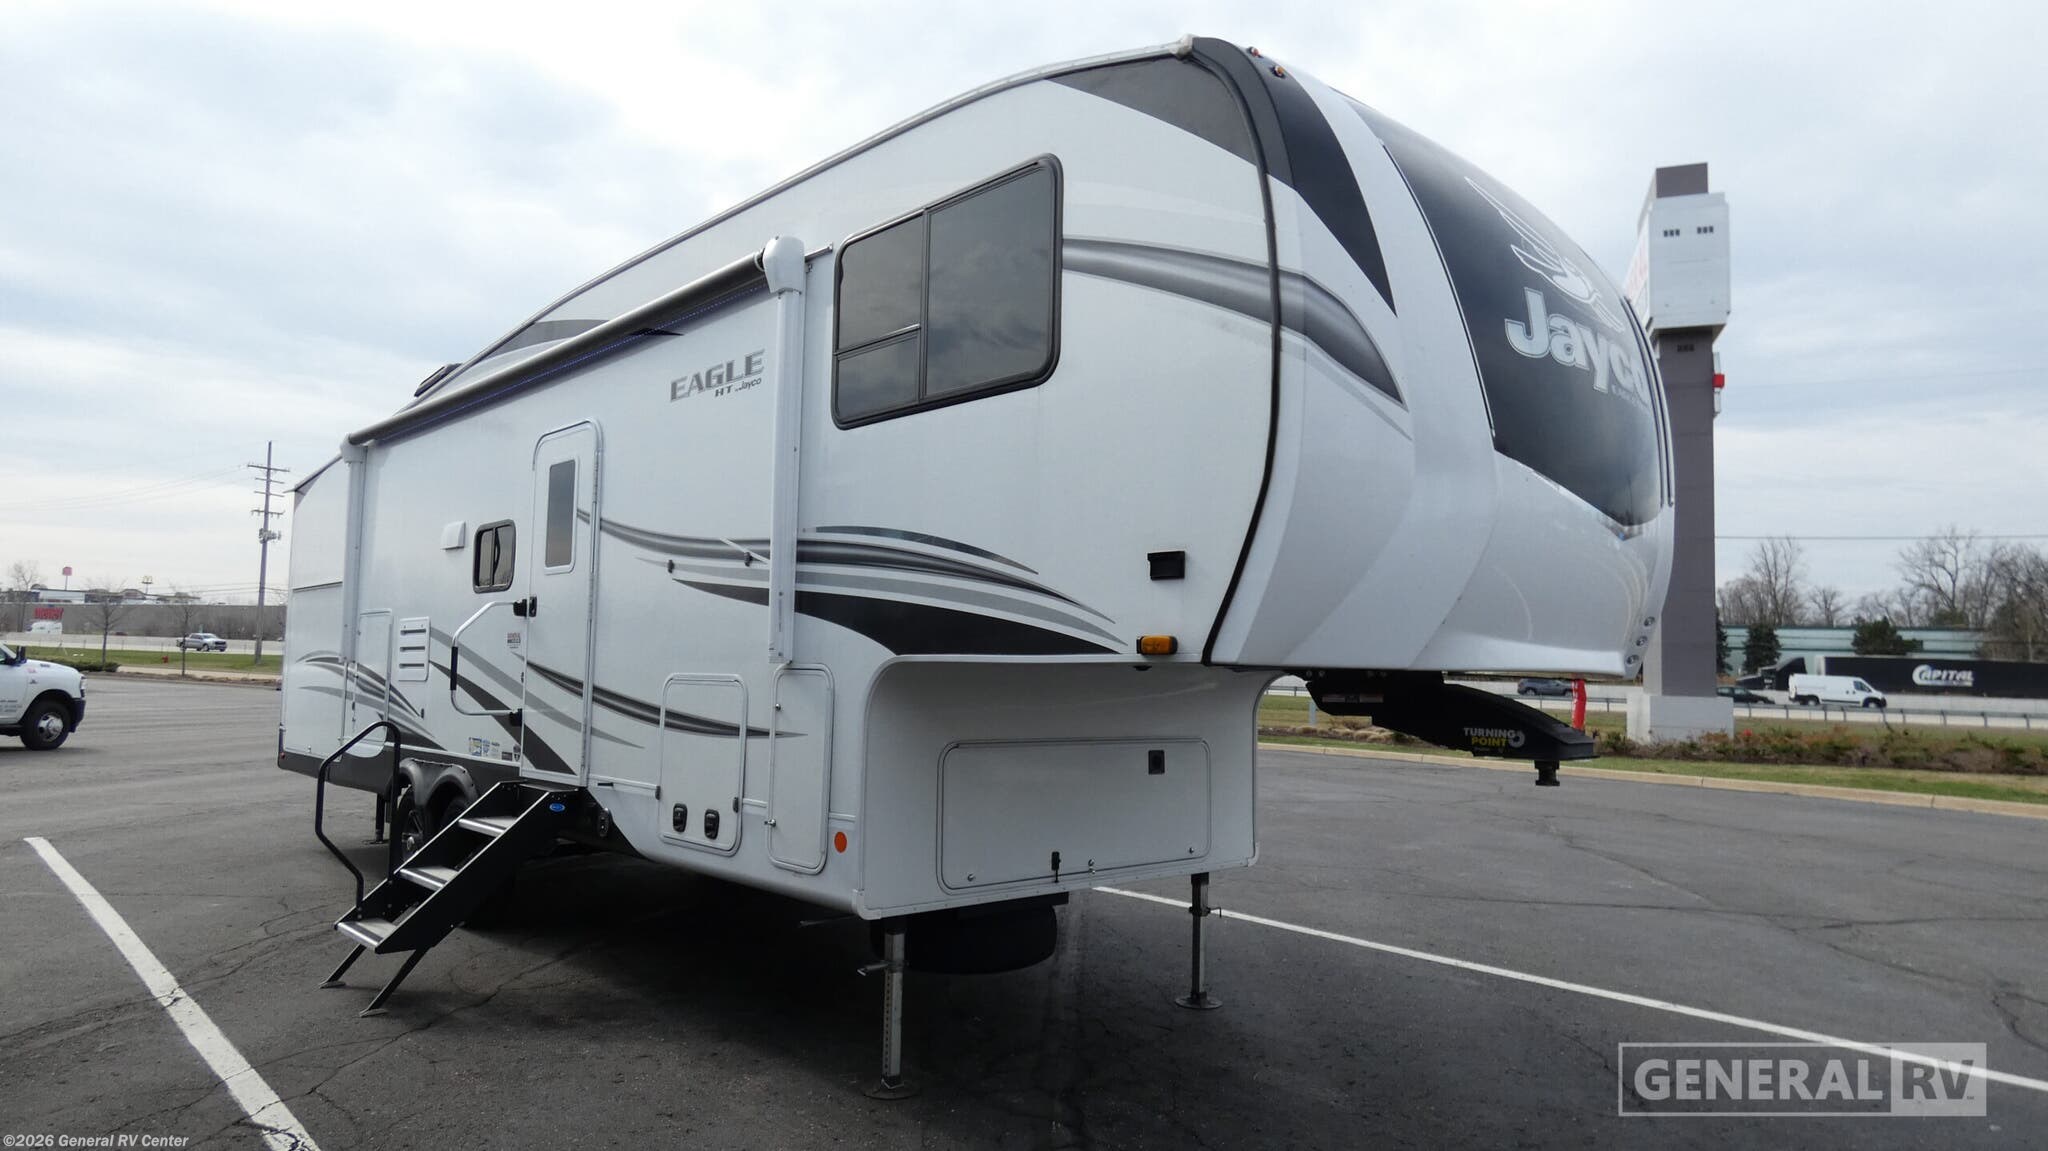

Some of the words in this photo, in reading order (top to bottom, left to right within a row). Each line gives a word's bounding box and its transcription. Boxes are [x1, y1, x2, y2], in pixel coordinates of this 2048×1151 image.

[670, 348, 765, 402] EAGLE
[715, 384, 734, 397] HT
[1912, 664, 1974, 687] CAPITAL
[1463, 727, 1516, 738] TURNING
[1471, 736, 1506, 747] POINT
